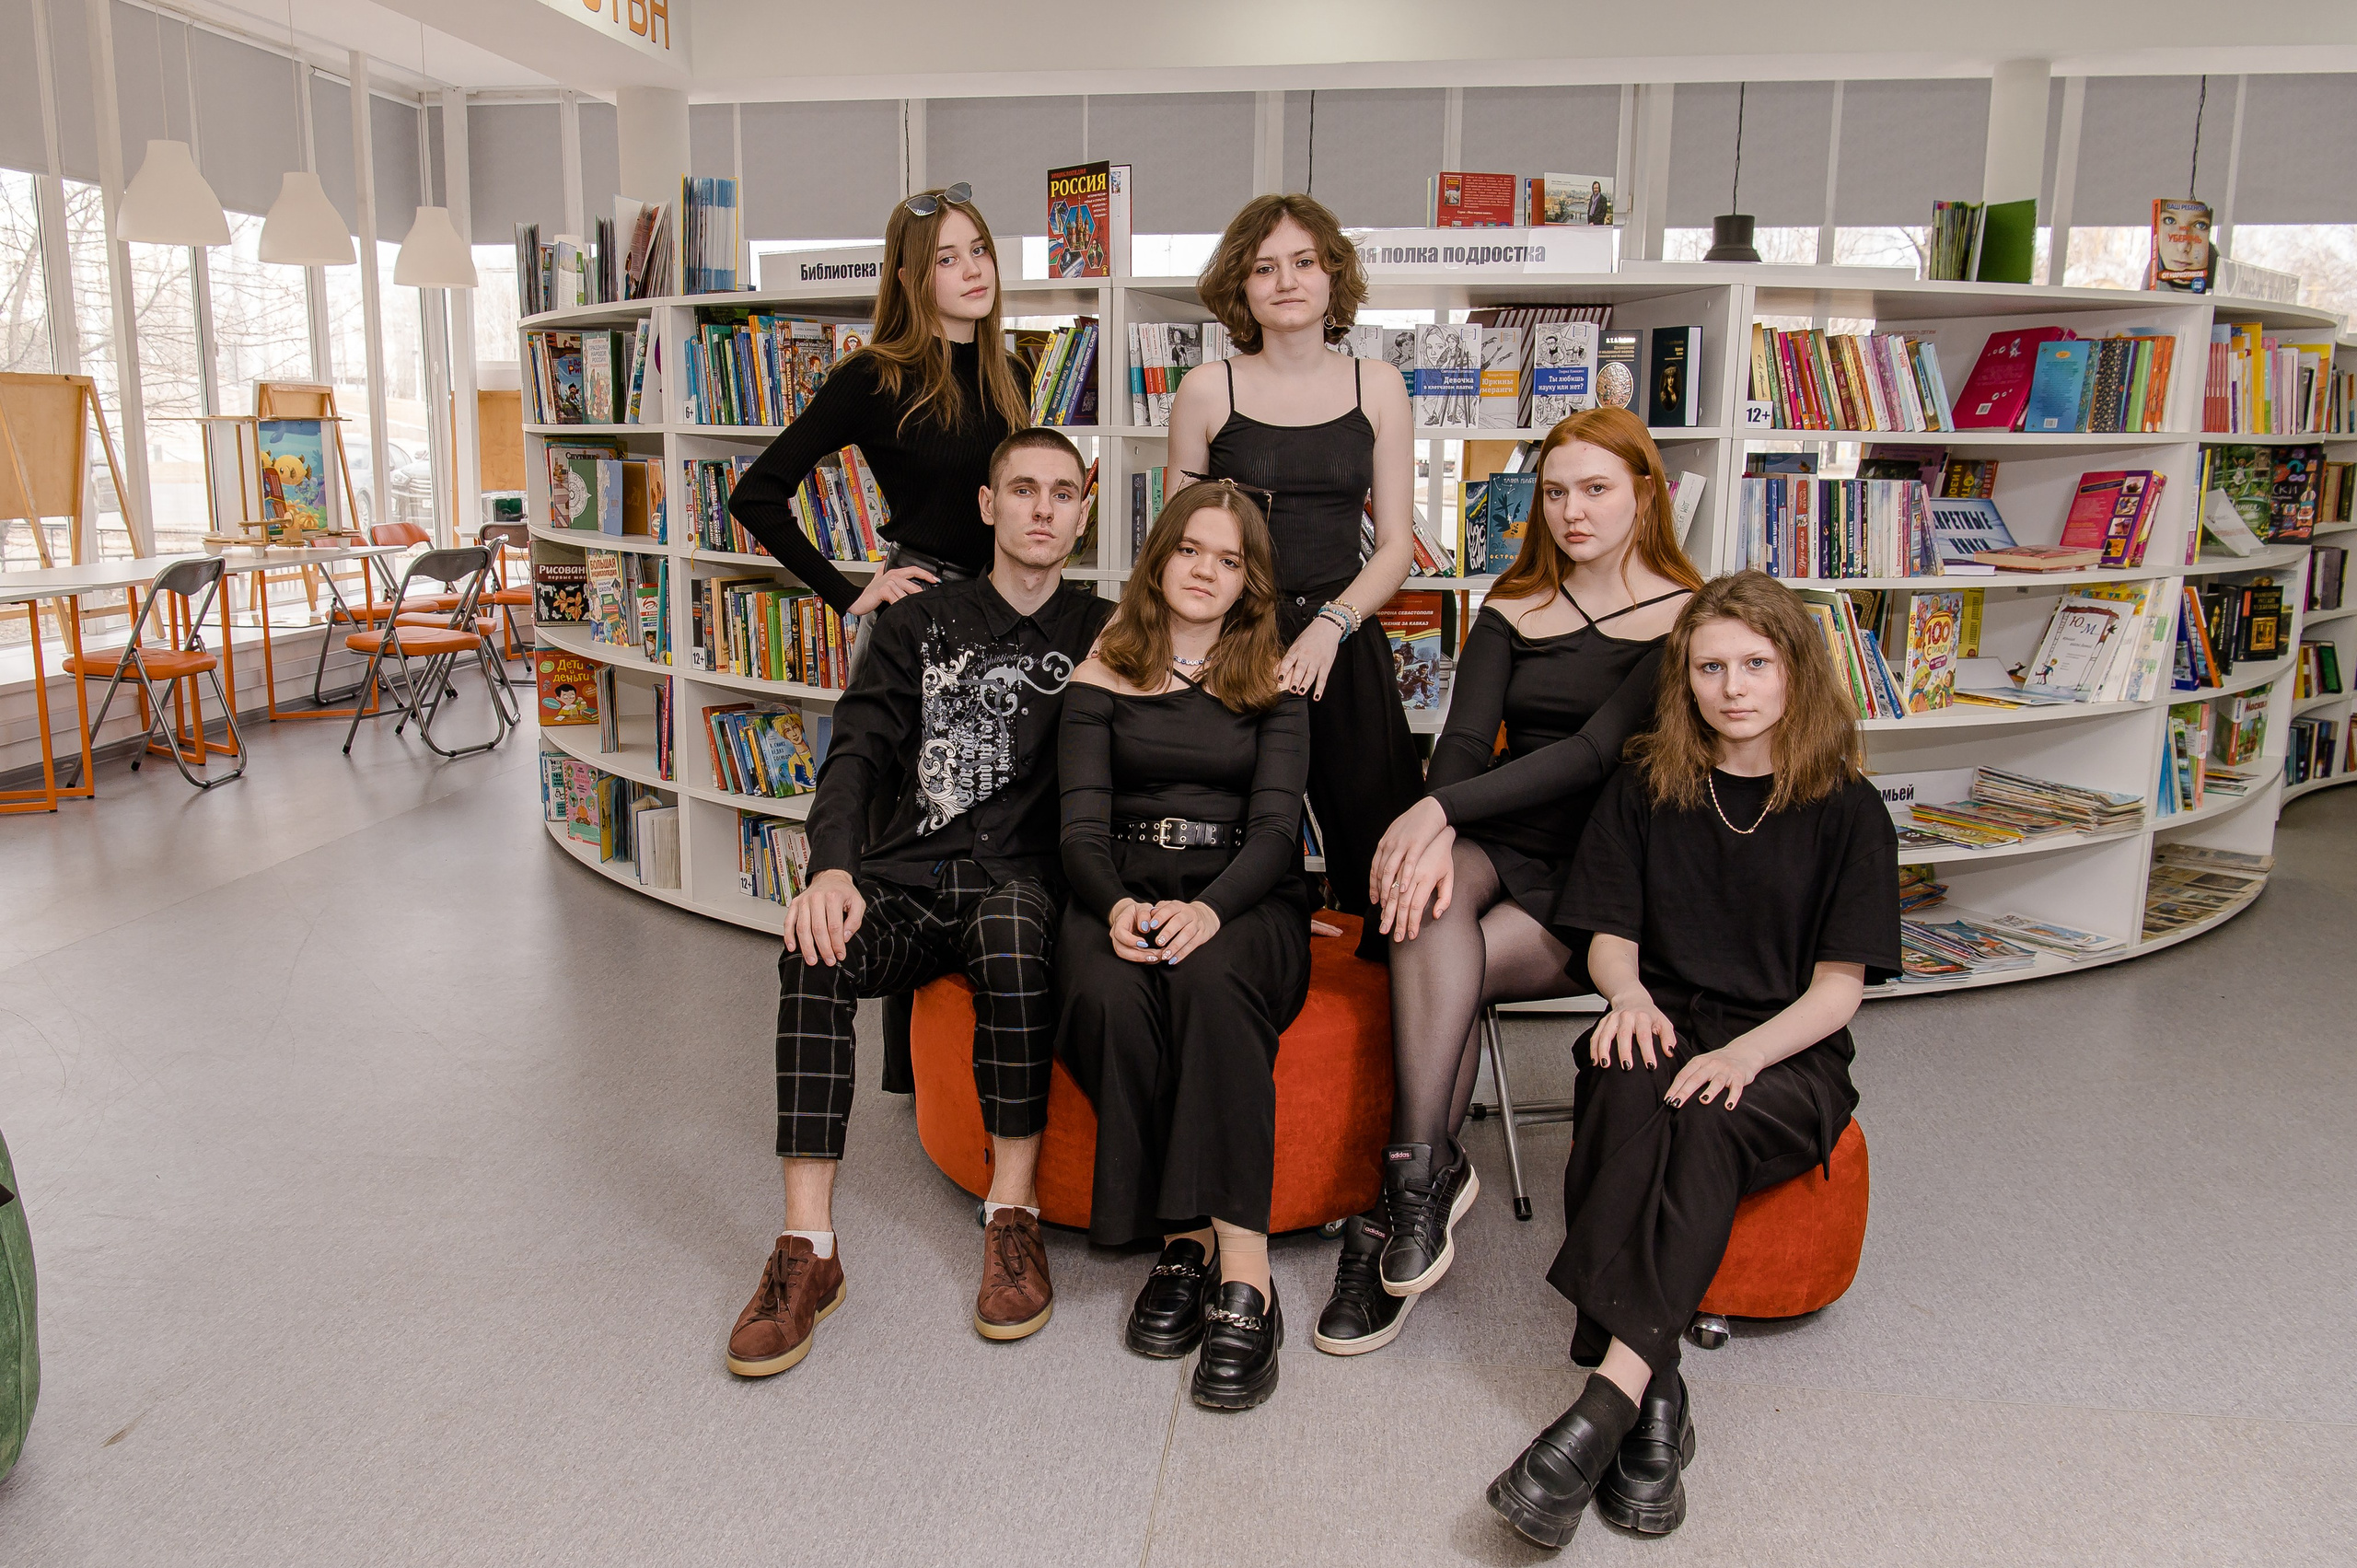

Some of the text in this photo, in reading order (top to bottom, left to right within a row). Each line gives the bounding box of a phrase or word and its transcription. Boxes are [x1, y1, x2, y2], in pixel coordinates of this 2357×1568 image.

[1051, 173, 1107, 198] РОССИЯ
[1381, 247, 1438, 263] полка
[1443, 246, 1546, 266] подростка
[800, 262, 877, 281] Библиотека
[1444, 377, 1474, 385] Девочка
[1482, 378, 1514, 386] Юркины
[685, 407, 694, 418] 6+
[1746, 407, 1771, 423] 12+
[686, 504, 693, 513] 13
[590, 559, 616, 570] БОЛЬШАЯ
[591, 569, 618, 578] ЭНЦИКЛОПЕДИЯ
[1926, 621, 1951, 645] 100
[1927, 645, 1948, 656] СТИХОВ
[693, 652, 704, 665] 12+
[557, 659, 584, 672] Дети
[553, 673, 590, 683] деньги
[2245, 700, 2268, 713] Москва
[740, 877, 752, 889] 12+
